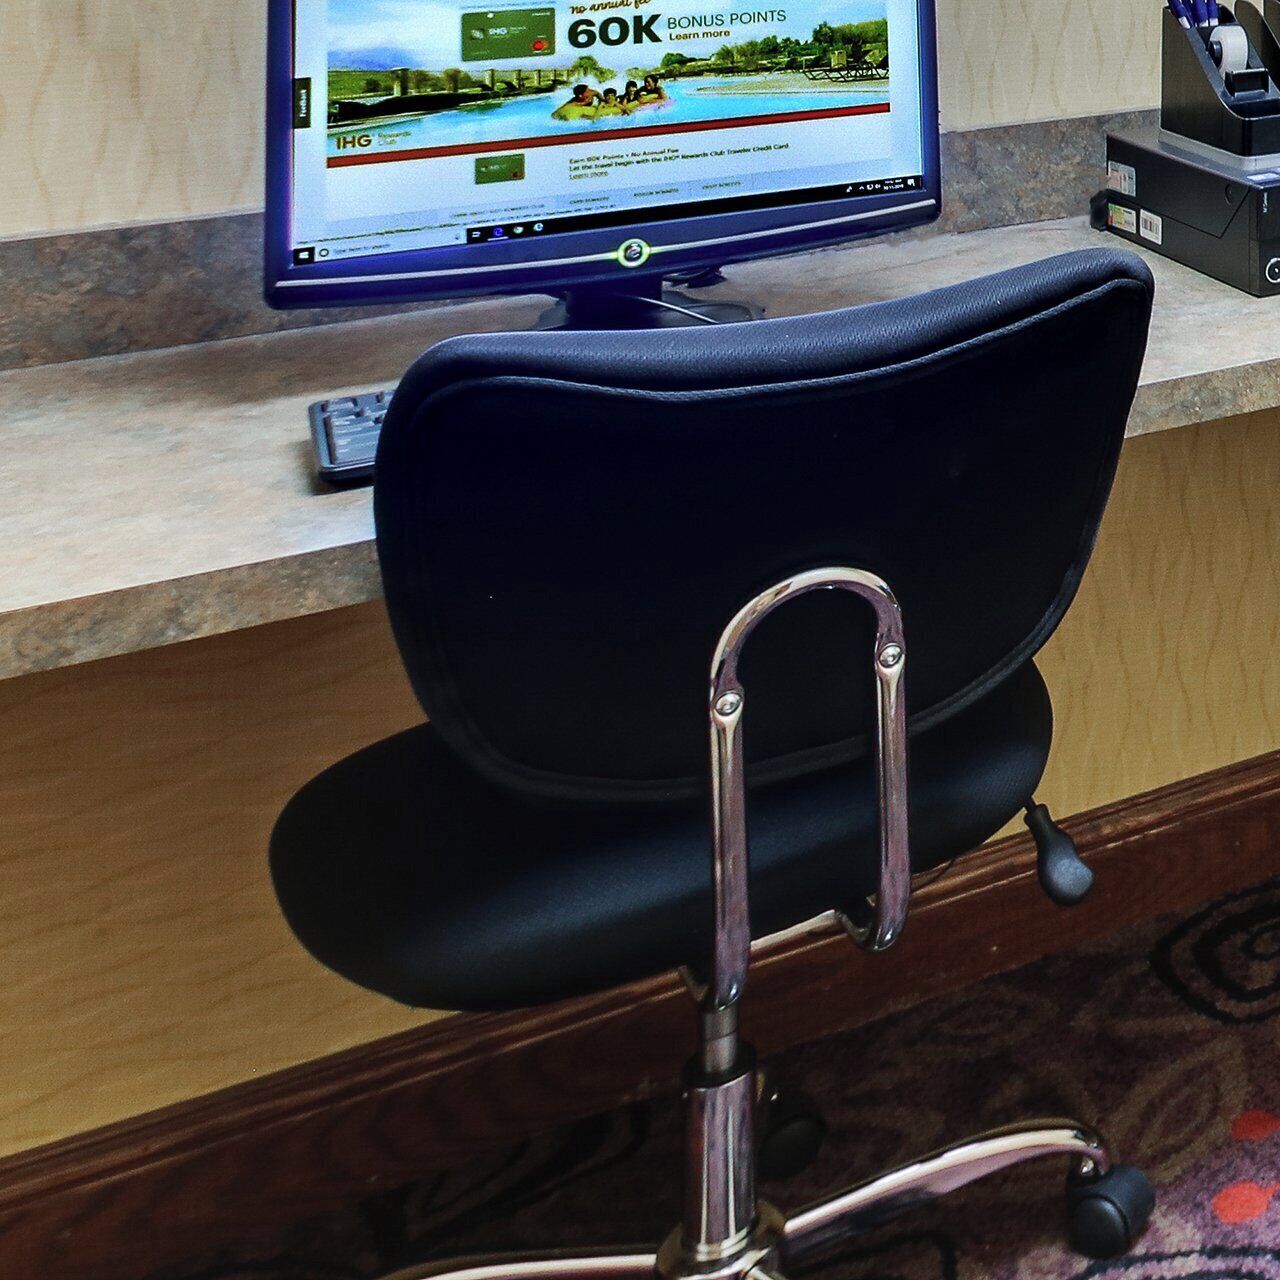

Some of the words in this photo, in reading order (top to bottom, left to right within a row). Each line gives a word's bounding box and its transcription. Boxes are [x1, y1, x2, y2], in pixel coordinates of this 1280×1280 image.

[569, 4, 587, 15] no
[668, 15, 725, 30] BONUS
[729, 9, 787, 25] POINTS
[567, 13, 663, 49] 60K
[669, 30, 707, 41] Learn
[709, 29, 731, 39] more
[336, 133, 372, 150] IHG
